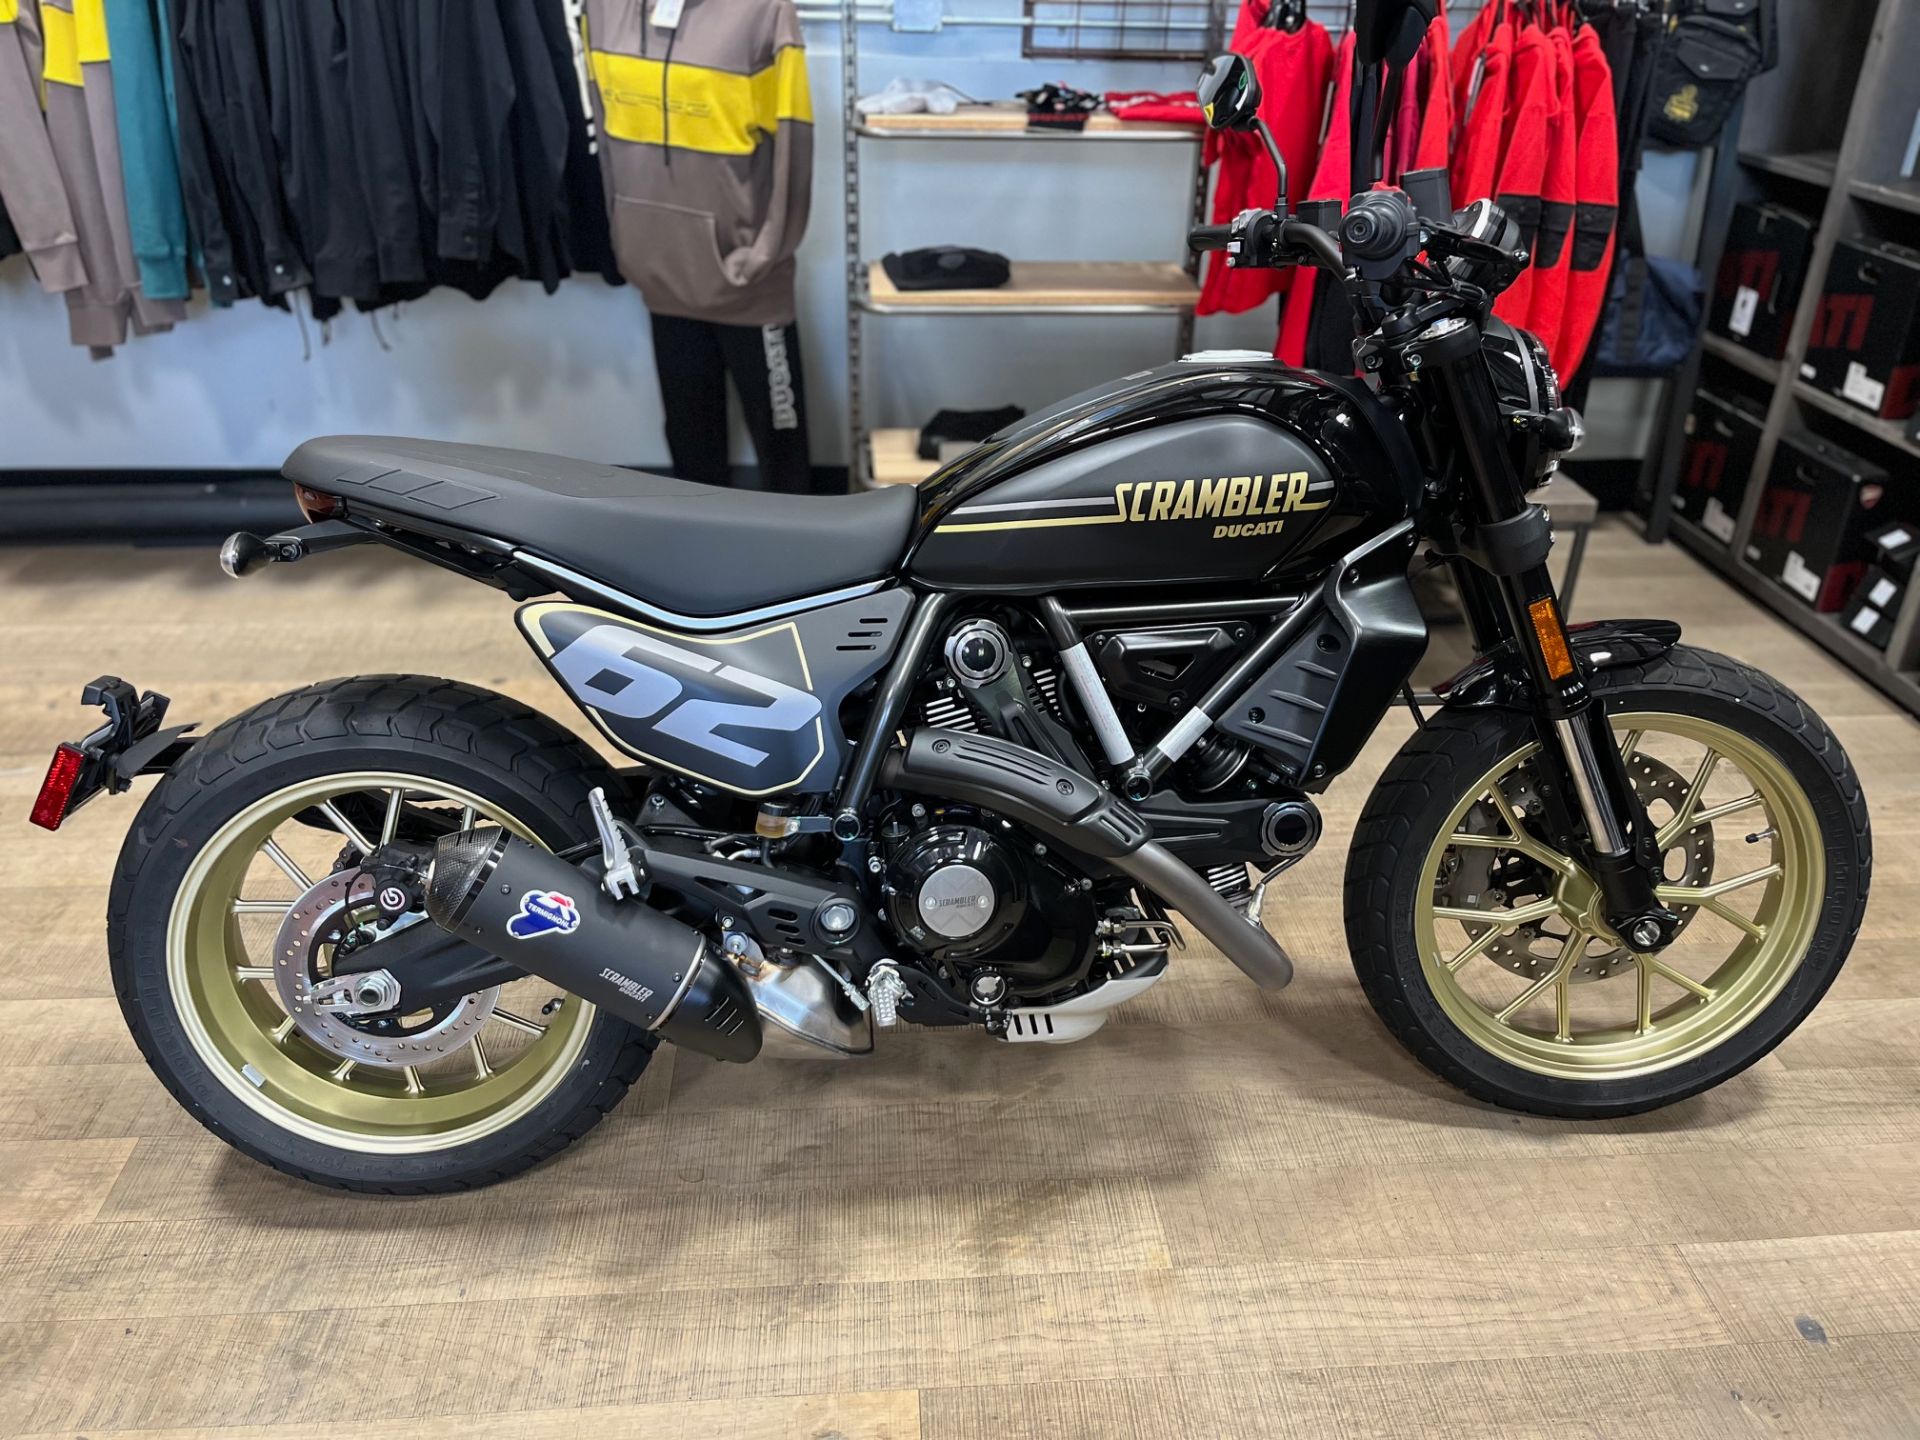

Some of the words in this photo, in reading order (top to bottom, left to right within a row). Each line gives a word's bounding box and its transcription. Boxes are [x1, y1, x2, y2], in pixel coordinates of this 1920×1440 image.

[1114, 471, 1309, 523] SCRAMBLER
[1213, 520, 1284, 539] DUCATI
[550, 624, 822, 768] 62
[528, 902, 571, 929] TERMIGNONI
[938, 895, 977, 908] SCRAMBLER
[599, 967, 655, 999] SCRAMBLER
